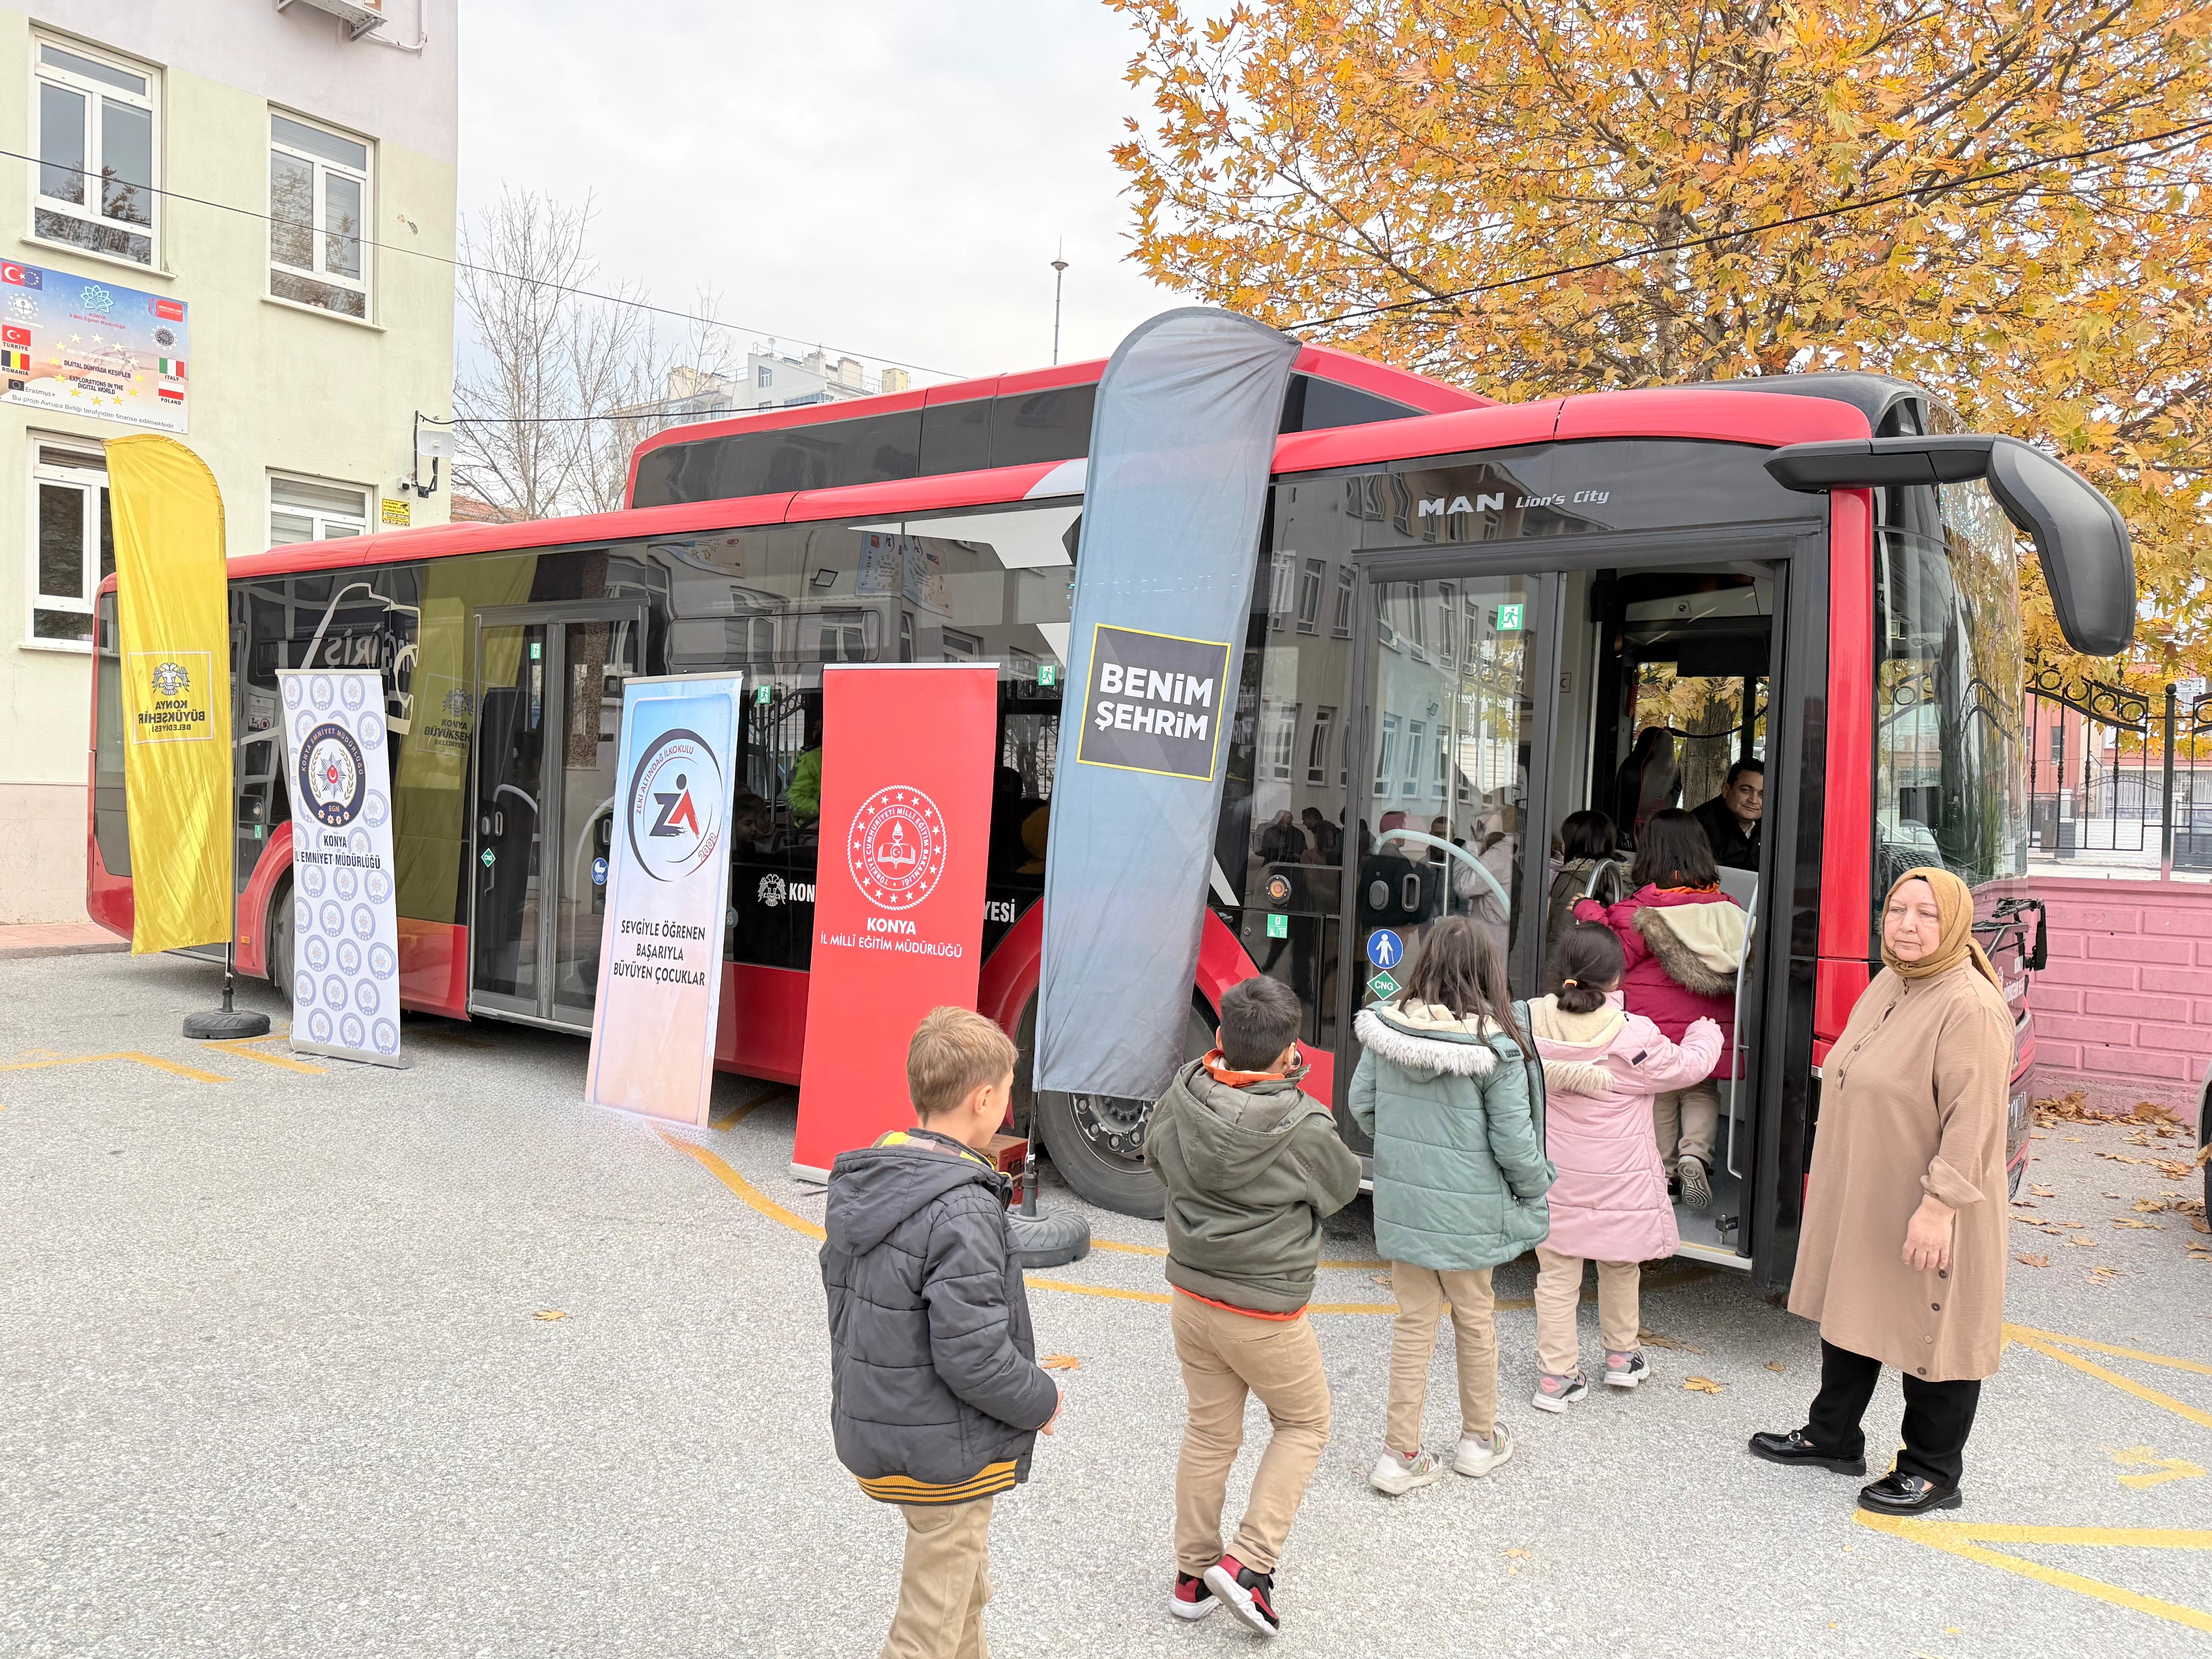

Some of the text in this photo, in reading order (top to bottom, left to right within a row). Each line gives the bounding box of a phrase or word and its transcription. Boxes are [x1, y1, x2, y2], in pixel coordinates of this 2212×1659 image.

[2, 367, 29, 376] ROMANIA
[64, 359, 83, 369] DİJİTAL
[84, 364, 107, 373] DÜNYADA
[25, 387, 56, 397] Erasmus+
[69, 375, 107, 388] EXPLORATIONS
[78, 383, 96, 391] DIGITAL
[41, 400, 63, 408] Avrupa
[65, 404, 82, 413] Birliği
[84, 408, 114, 417] tarafından
[116, 413, 137, 422] finanse
[1418, 490, 1610, 517] MAN Lion's City
[302, 728, 363, 775] KONYA EMNİYET MÜDÜRLÜĞÜ
[636, 745, 694, 814] ZEKİ ALTINDAĞ İLKOKULU
[324, 835, 347, 848] KONYA
[866, 807, 895, 855] CUMHURİYETİ
[915, 819, 929, 847] EĞİTİM
[295, 848, 380, 869] İL EMNİYET MÜDÜRLÜĞÜ
[698, 833, 718, 862] 2002
[867, 857, 888, 886] TÜRKİYE
[902, 850, 928, 886] BAKANLIĞI
[789, 883, 815, 903] KON
[621, 918, 706, 941] SEVGİYLE ÖĞRENEN
[867, 917, 916, 935] KONYA
[636, 943, 683, 961] BAŞARIYLA
[820, 931, 828, 944] İL
[858, 935, 892, 951] EĞİTİM
[895, 939, 962, 958] MÜDÜRLÜĞÜ
[613, 959, 705, 986] BÜYÜYEN ÇOCUKLAR
[1374, 980, 1394, 991] CNG
